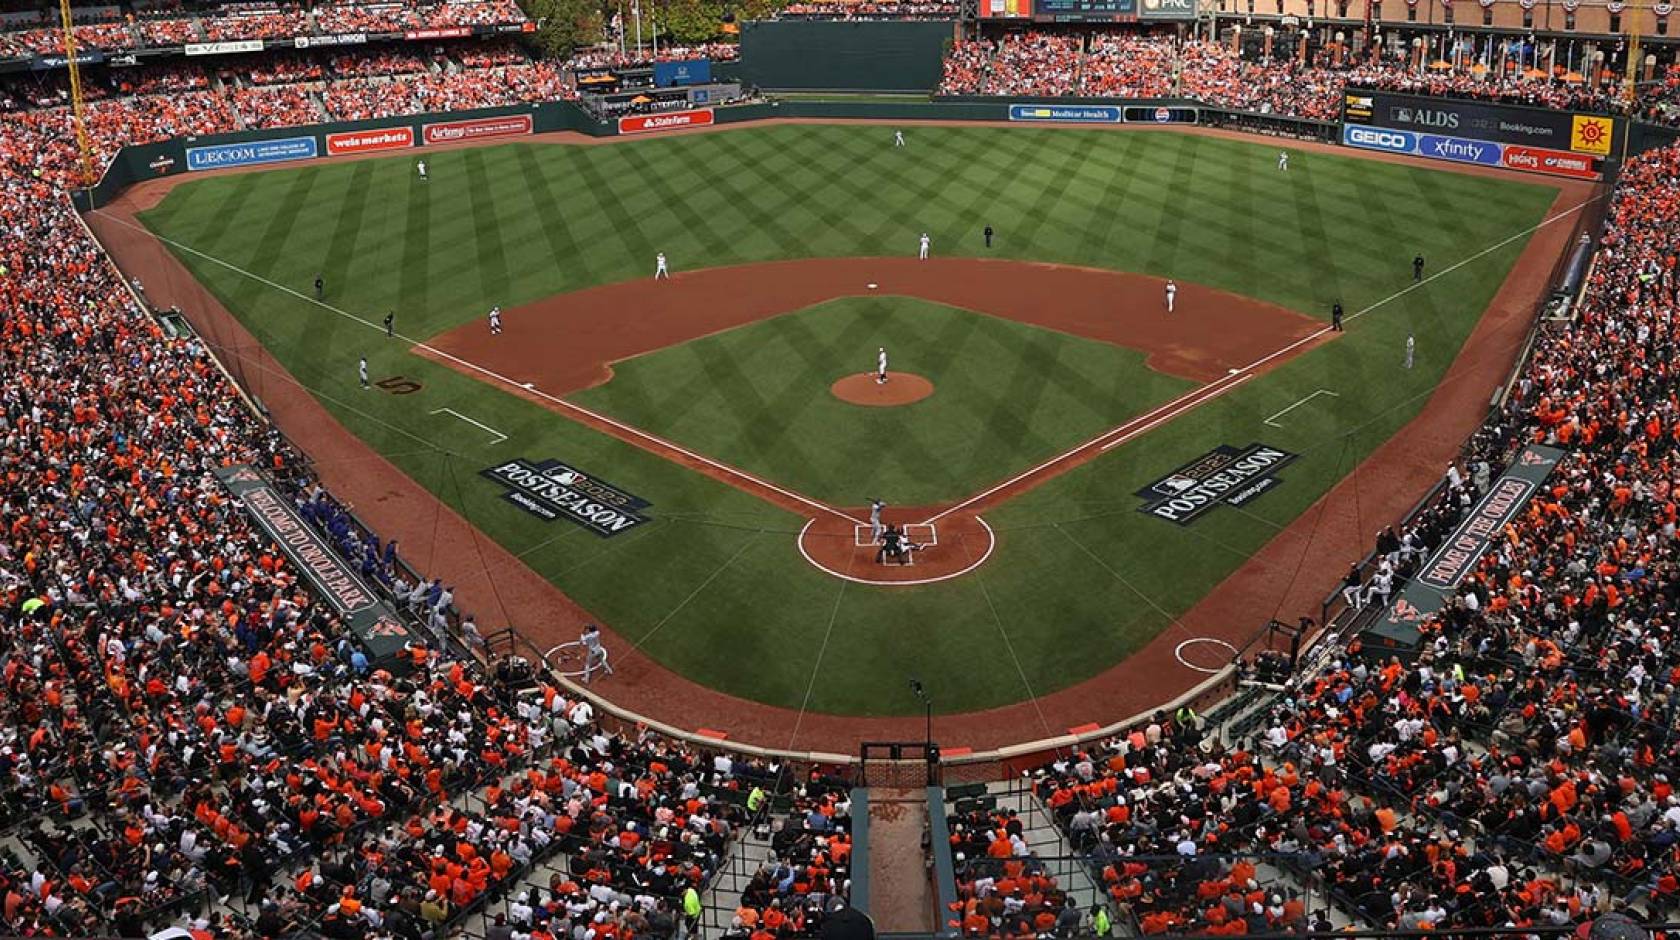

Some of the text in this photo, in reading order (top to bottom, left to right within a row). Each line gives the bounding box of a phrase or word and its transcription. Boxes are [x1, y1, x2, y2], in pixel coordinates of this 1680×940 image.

[1083, 110, 1109, 119] Health
[1414, 109, 1459, 128] ALDS
[334, 132, 407, 147] weis markets
[1350, 125, 1405, 148] GEICO
[1500, 120, 1553, 136] Booking.com
[1434, 137, 1483, 160] xfinity
[1153, 447, 1286, 521] POSTSEASON
[494, 462, 635, 531] POSTSEASON
[1426, 479, 1527, 583] HOME OF THE ORIOLES
[250, 488, 368, 609] WELCOME TO ORIOLE PARK
